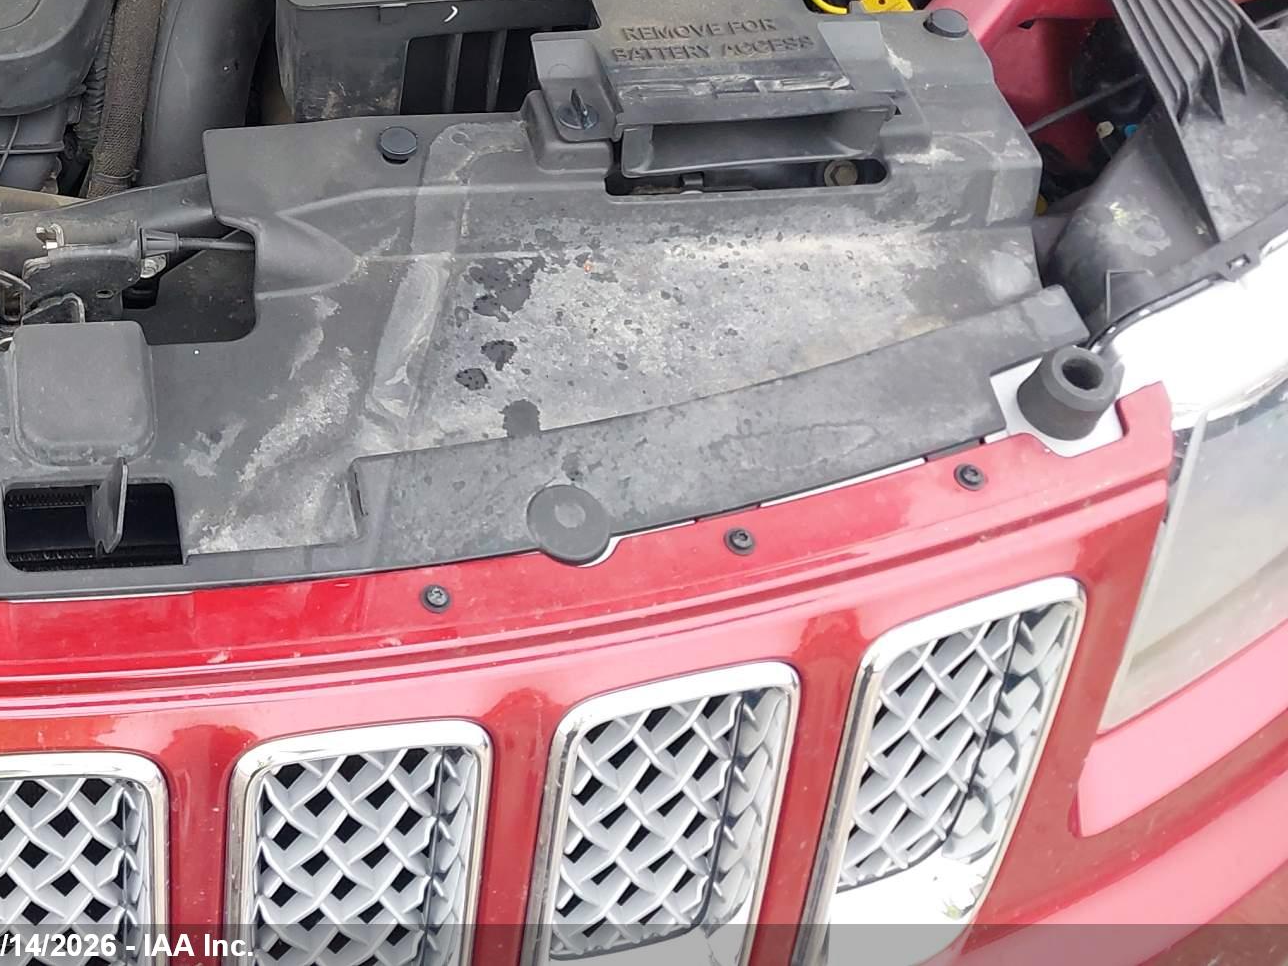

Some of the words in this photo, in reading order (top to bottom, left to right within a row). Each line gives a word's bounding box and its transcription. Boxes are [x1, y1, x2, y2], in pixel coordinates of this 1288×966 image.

[620, 22, 721, 42] REMOVE
[727, 18, 778, 36] FOR
[611, 43, 712, 63] BATTERY
[720, 35, 815, 58] ACCESS
